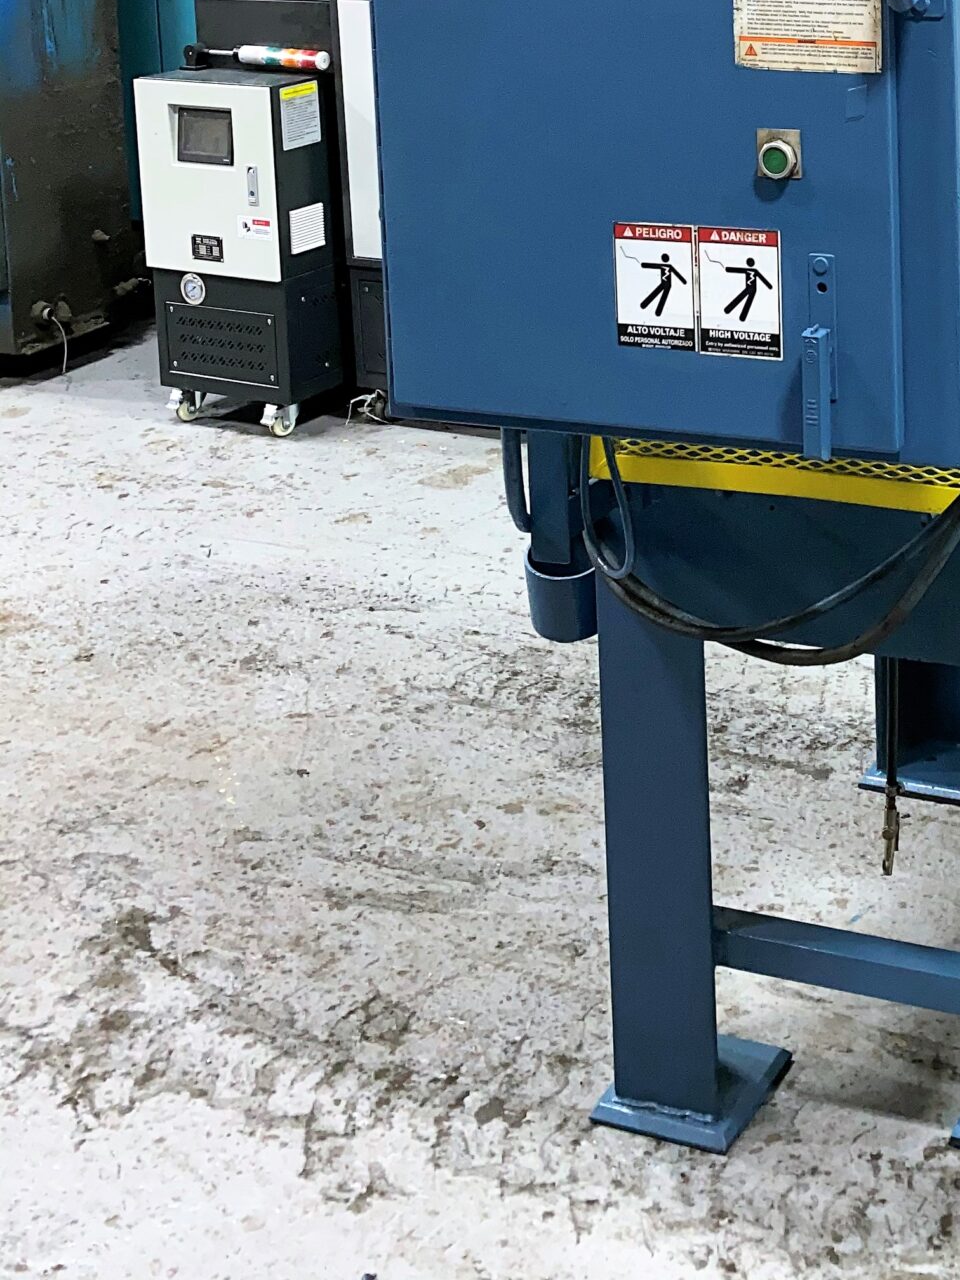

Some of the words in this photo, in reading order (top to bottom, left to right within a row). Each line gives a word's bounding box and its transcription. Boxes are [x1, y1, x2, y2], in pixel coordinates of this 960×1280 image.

[635, 227, 683, 240] PELIGRO
[721, 231, 767, 244] DANGER
[627, 325, 648, 335] ALTO
[649, 326, 686, 337] VOLTAJE
[709, 329, 731, 338] HIGH
[732, 331, 772, 342] VOLTAGE
[620, 335, 634, 343] SOLO
[634, 336, 661, 345] PERSONAL
[661, 339, 693, 347] AUTORIZADO
